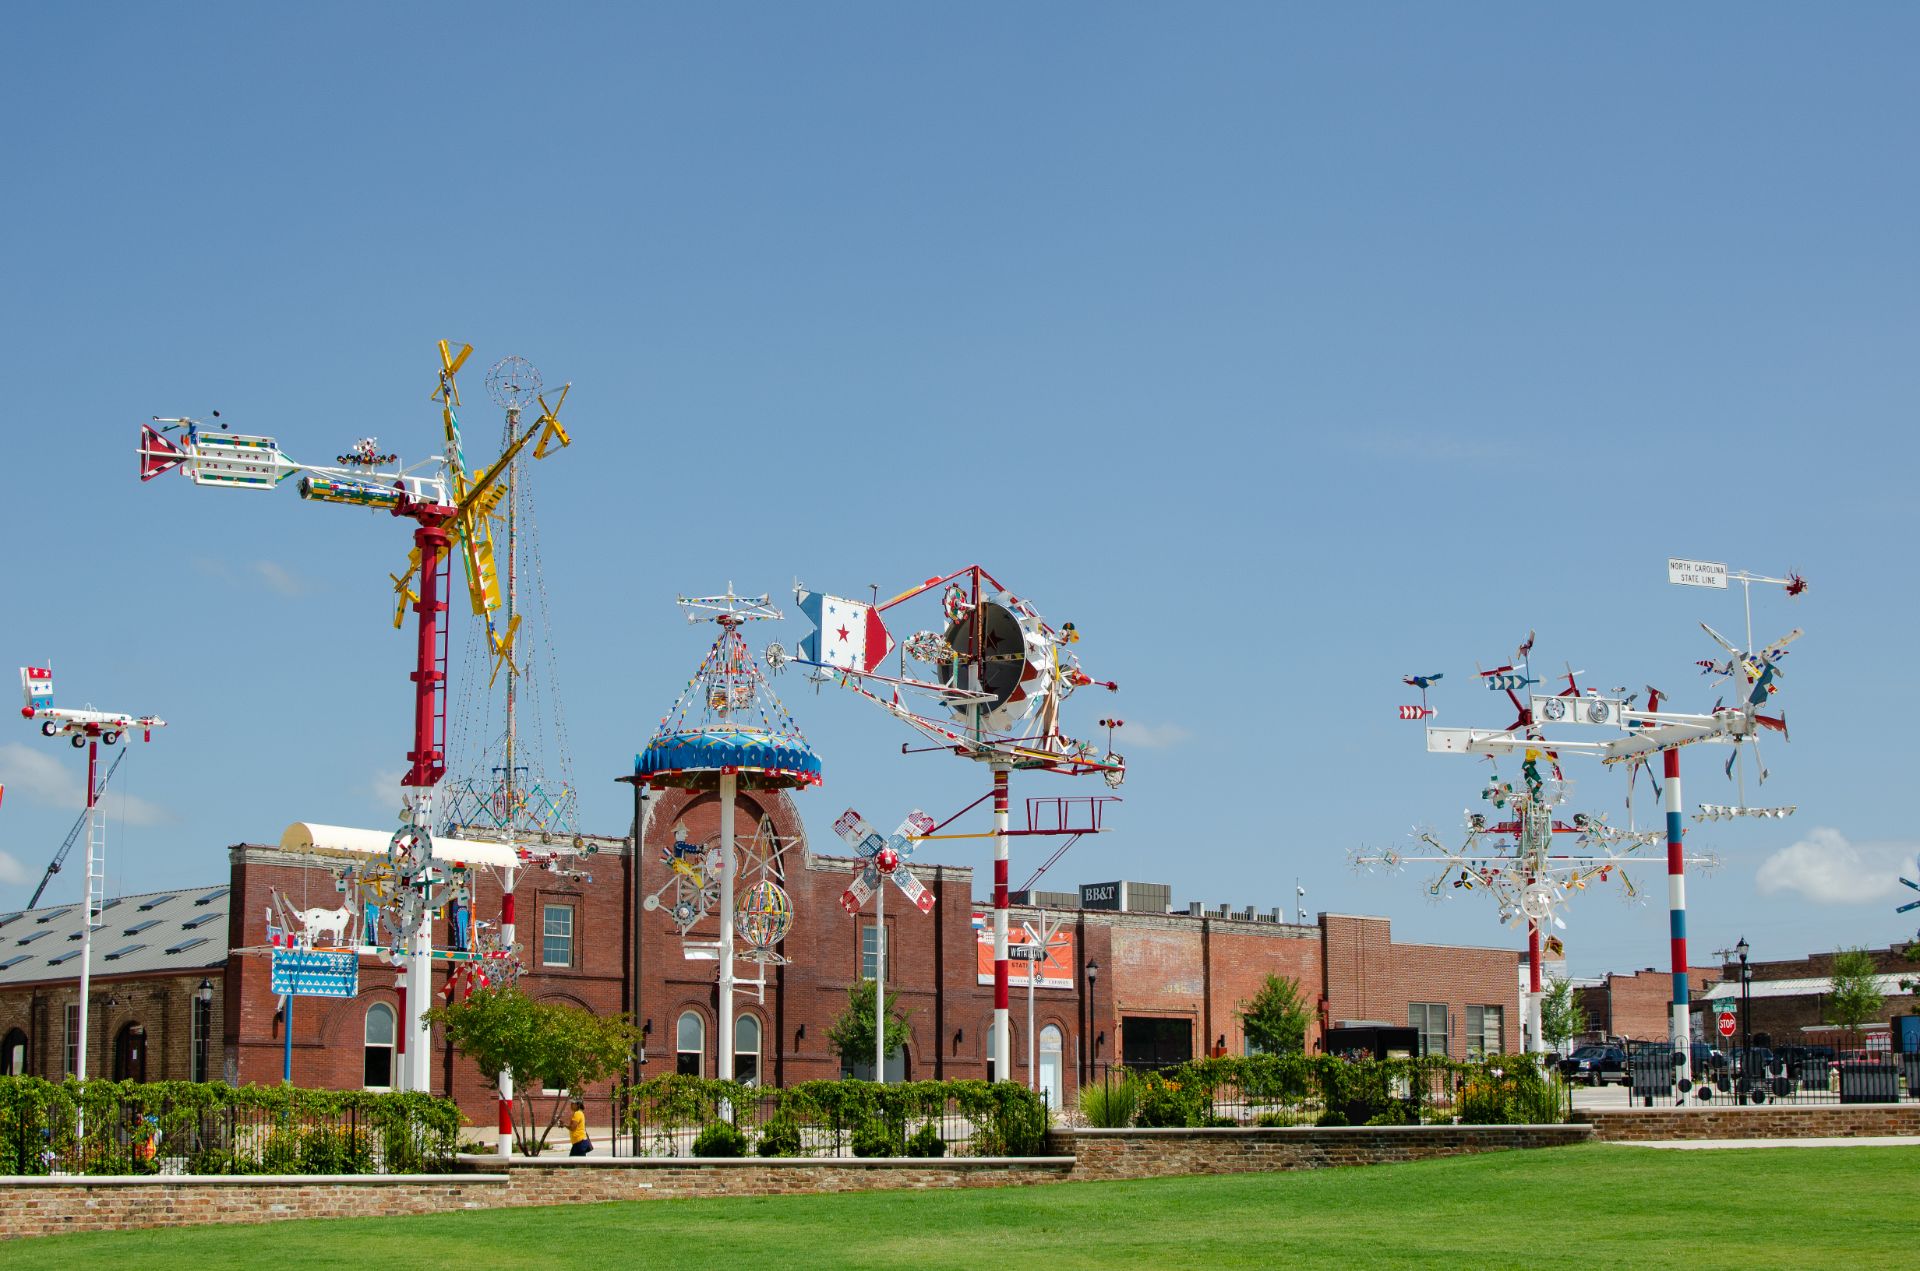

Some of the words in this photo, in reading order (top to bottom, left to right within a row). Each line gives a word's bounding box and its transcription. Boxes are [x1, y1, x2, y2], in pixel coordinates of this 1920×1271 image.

[1670, 562, 1691, 571] NORTH
[1694, 564, 1724, 574] CAROLINA
[1681, 574, 1699, 583] STATE
[1702, 576, 1716, 584] LINE
[1085, 886, 1115, 901] BB&T
[1719, 1019, 1735, 1029] STOP
